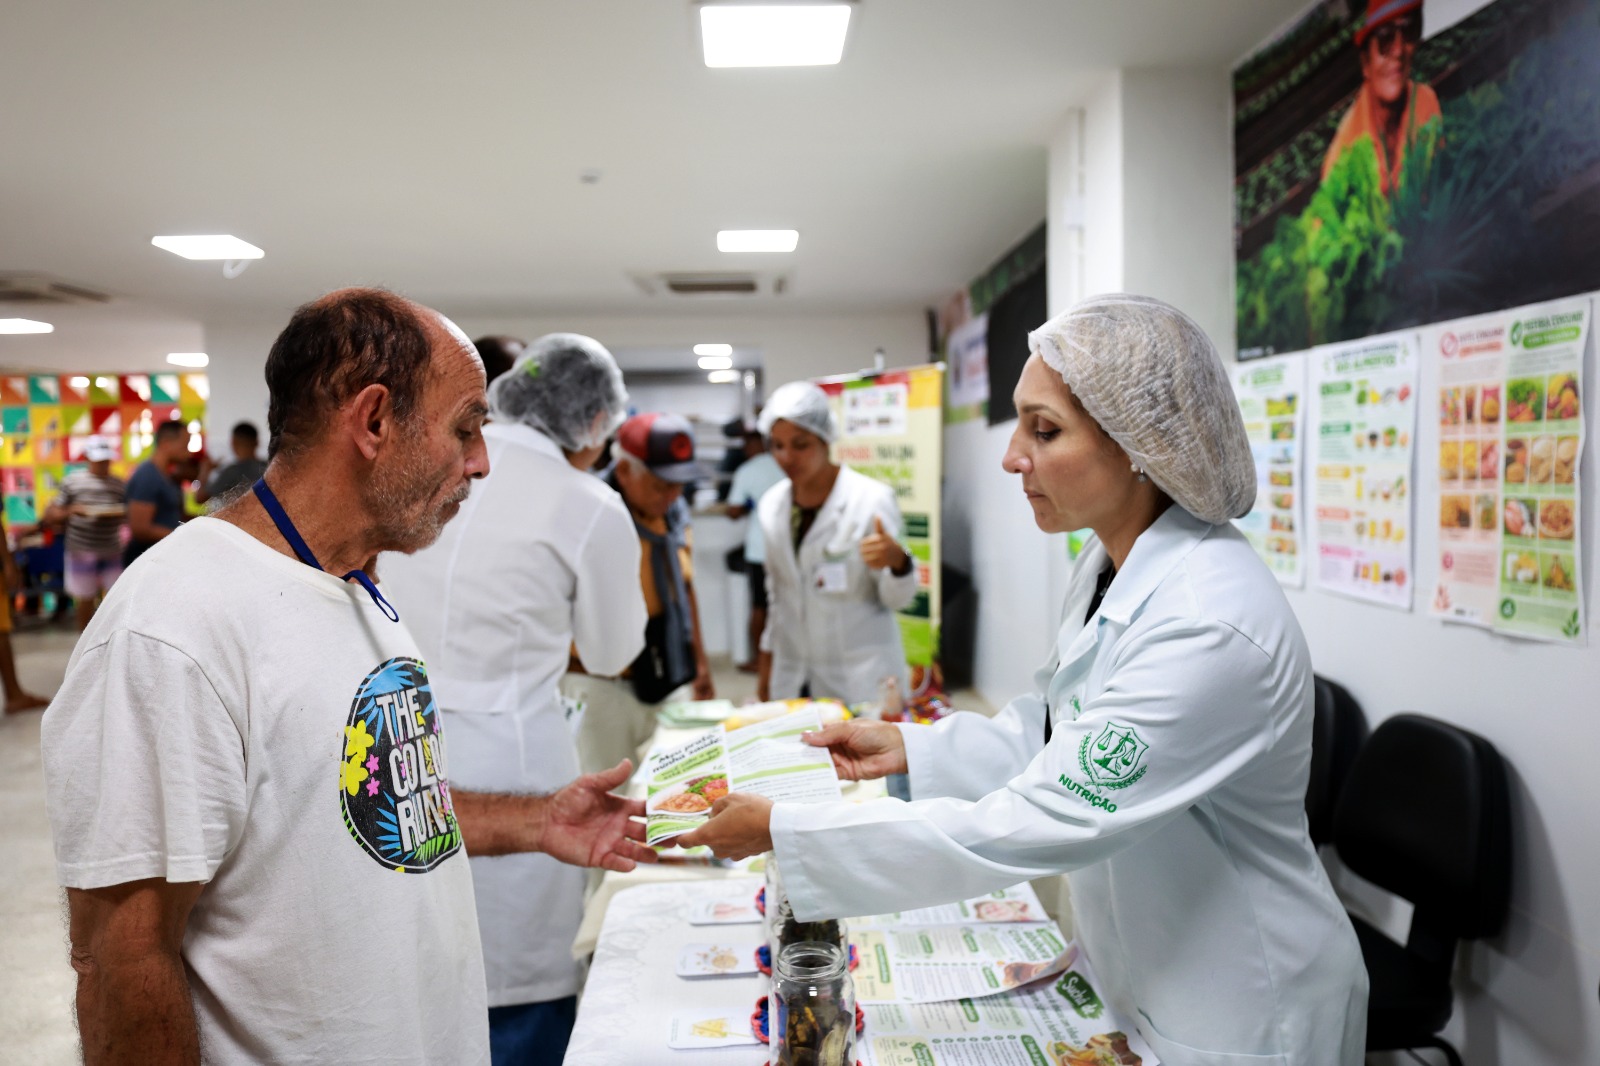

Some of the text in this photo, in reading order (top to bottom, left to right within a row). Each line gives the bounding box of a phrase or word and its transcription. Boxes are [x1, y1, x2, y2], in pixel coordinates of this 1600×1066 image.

[376, 688, 425, 745] THE
[397, 784, 448, 852] RUN
[1058, 773, 1117, 813] NUTRIÇÃO
